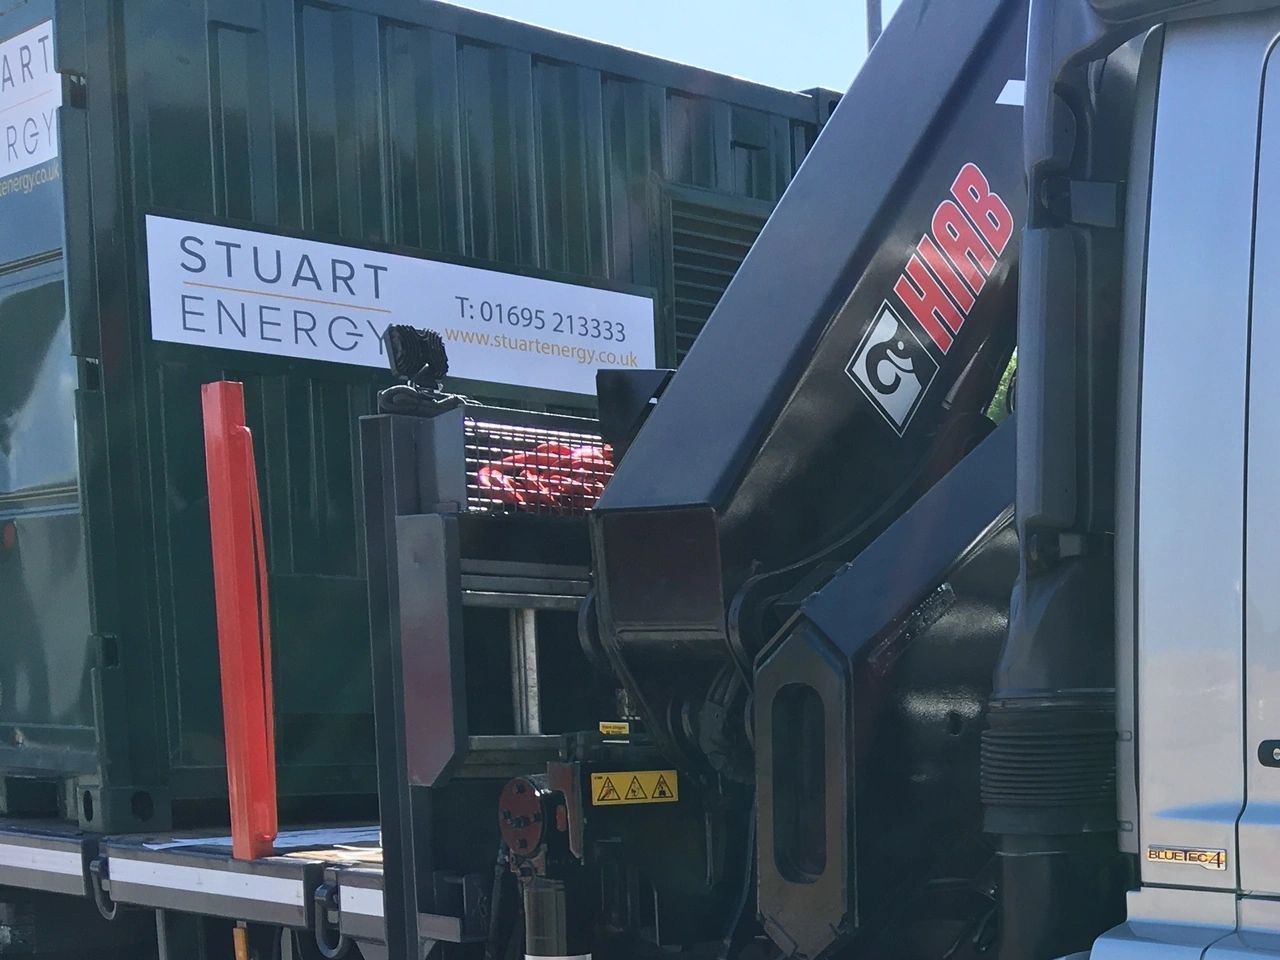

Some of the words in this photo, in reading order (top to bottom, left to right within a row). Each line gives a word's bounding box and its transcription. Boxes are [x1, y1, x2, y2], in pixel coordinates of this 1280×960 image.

[179, 235, 388, 300] STUART
[893, 162, 1014, 356] HIAB
[181, 294, 386, 355] ENERGY
[445, 327, 638, 368] www.stuartenergy.co.uk
[455, 296, 474, 319] T:
[480, 301, 545, 330] 01695
[552, 312, 626, 342] 213333
